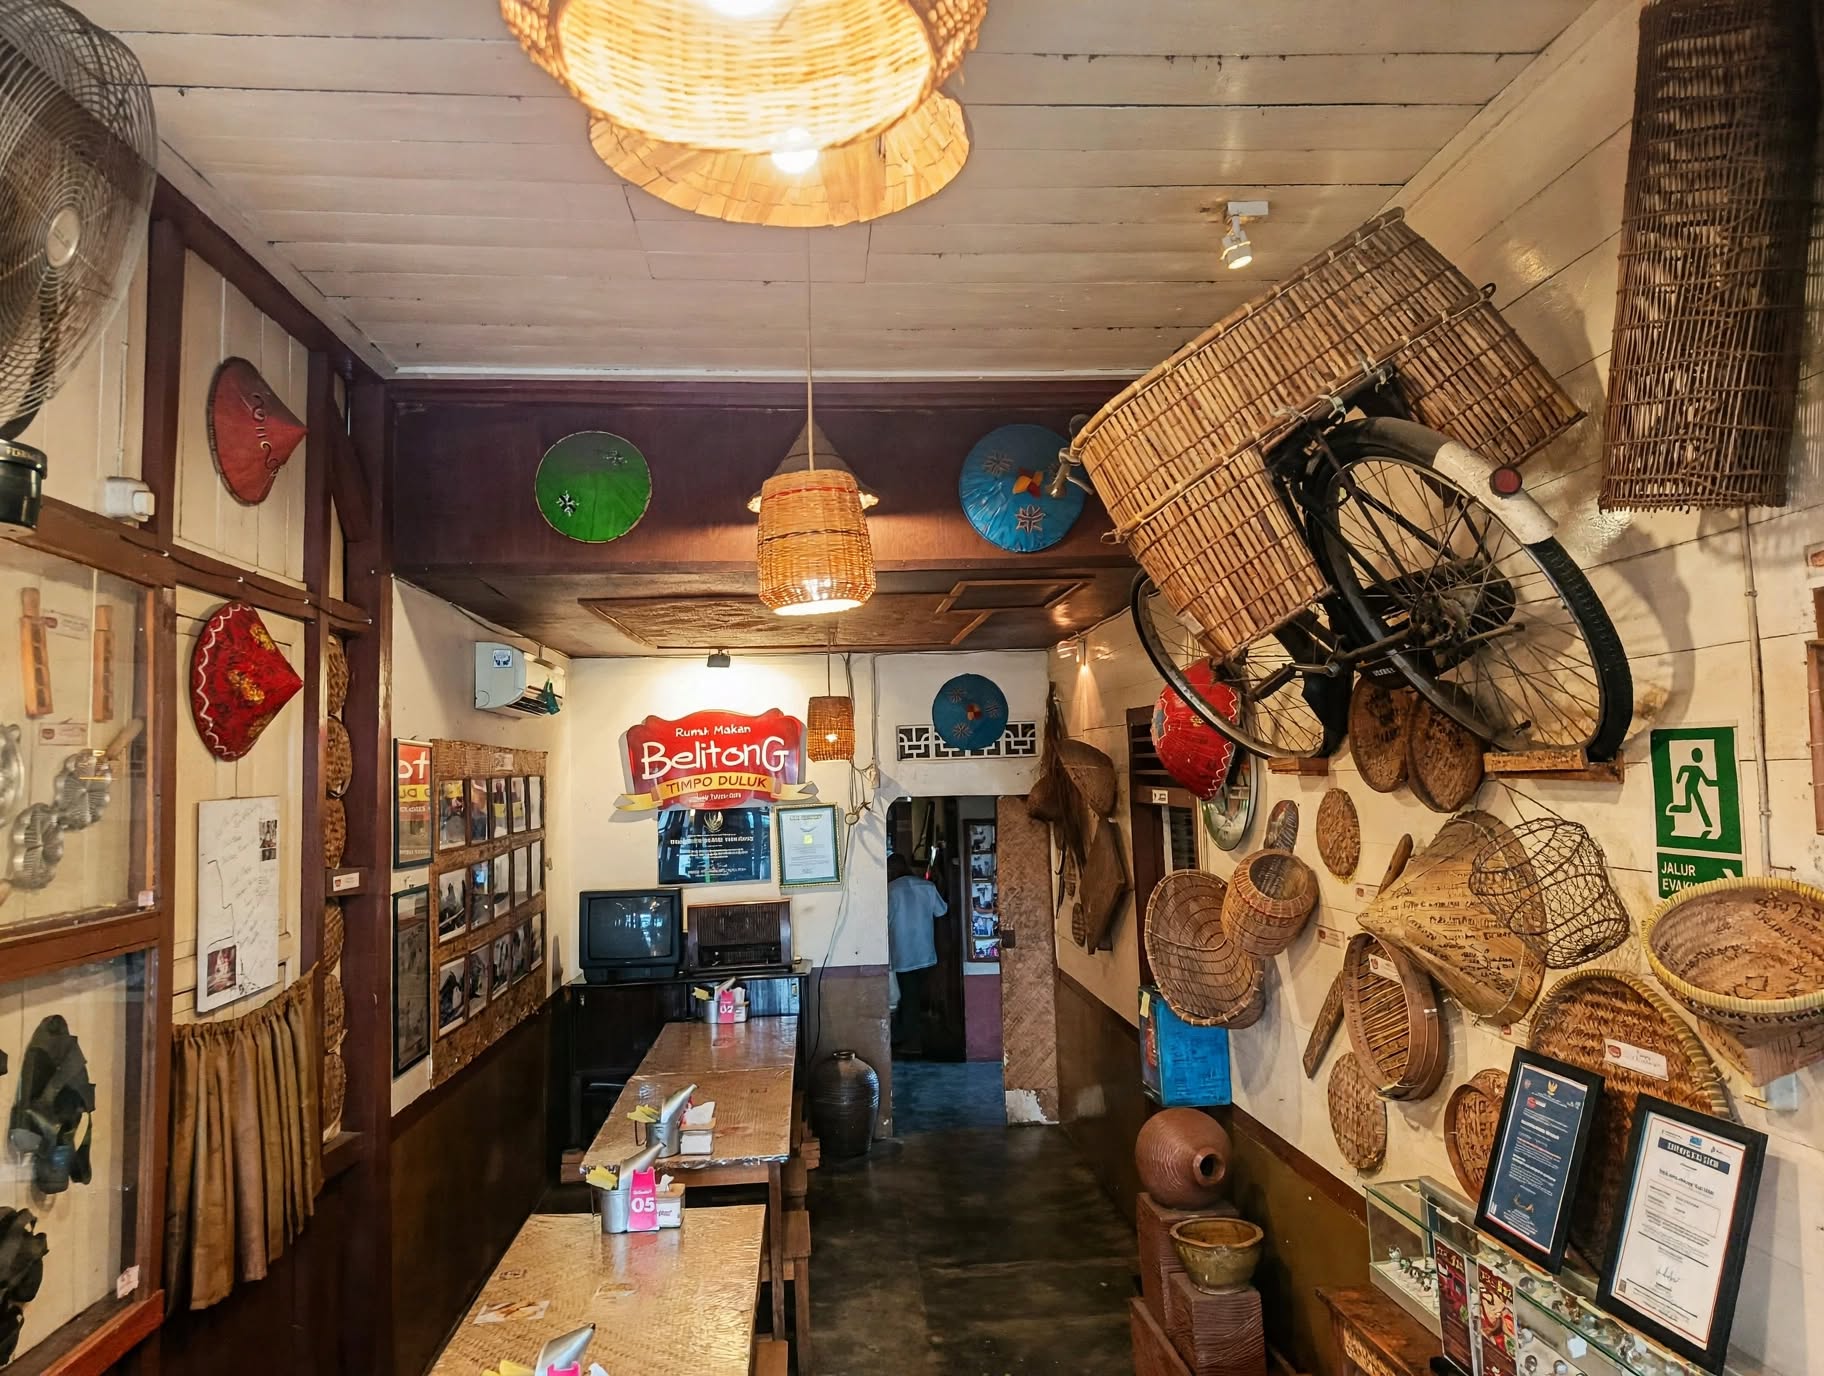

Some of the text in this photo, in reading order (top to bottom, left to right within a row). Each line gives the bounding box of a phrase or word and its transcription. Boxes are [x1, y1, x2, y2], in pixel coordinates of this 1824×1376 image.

[713, 723, 751, 736] Makan
[666, 775, 768, 795] TIMPO DULUK
[1661, 861, 1696, 876] JALUR
[1662, 878, 1699, 891] EVAK
[631, 1197, 655, 1213] 05
